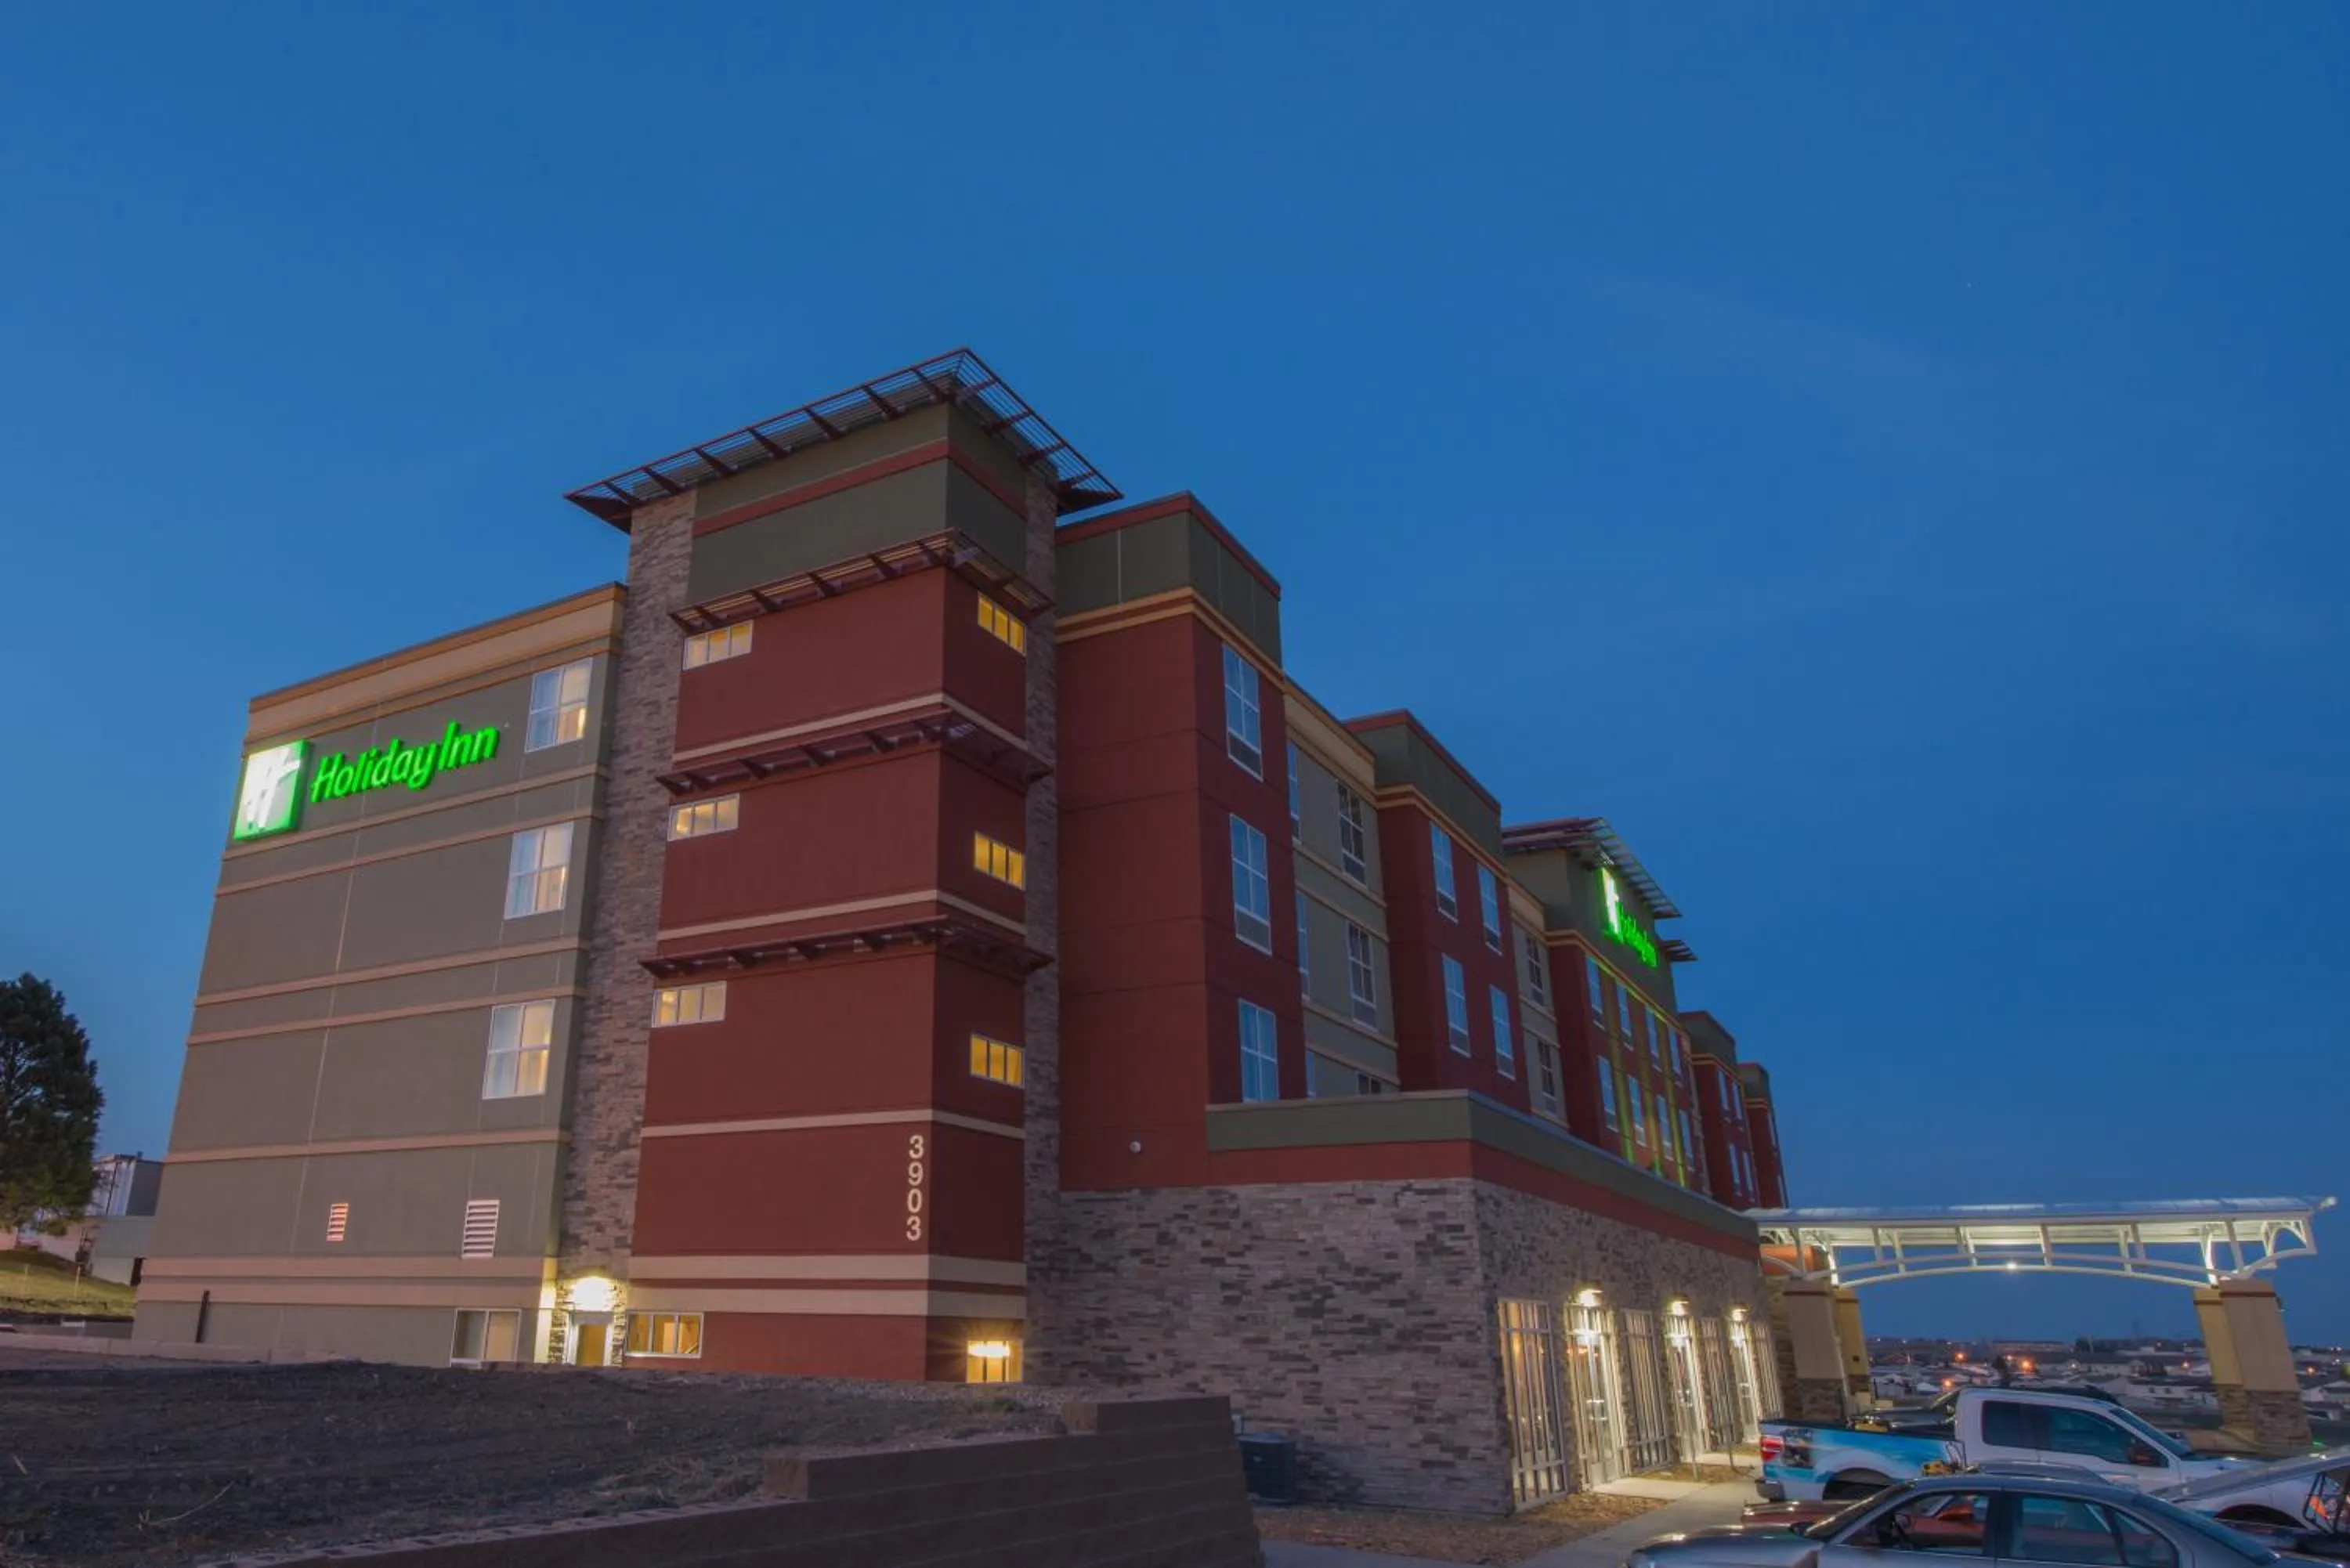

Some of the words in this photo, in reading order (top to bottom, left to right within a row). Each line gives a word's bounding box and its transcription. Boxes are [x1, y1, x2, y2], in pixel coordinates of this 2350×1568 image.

[310, 738, 437, 802] Holiday
[438, 720, 501, 771] Inn
[906, 1133, 924, 1241] 3903
